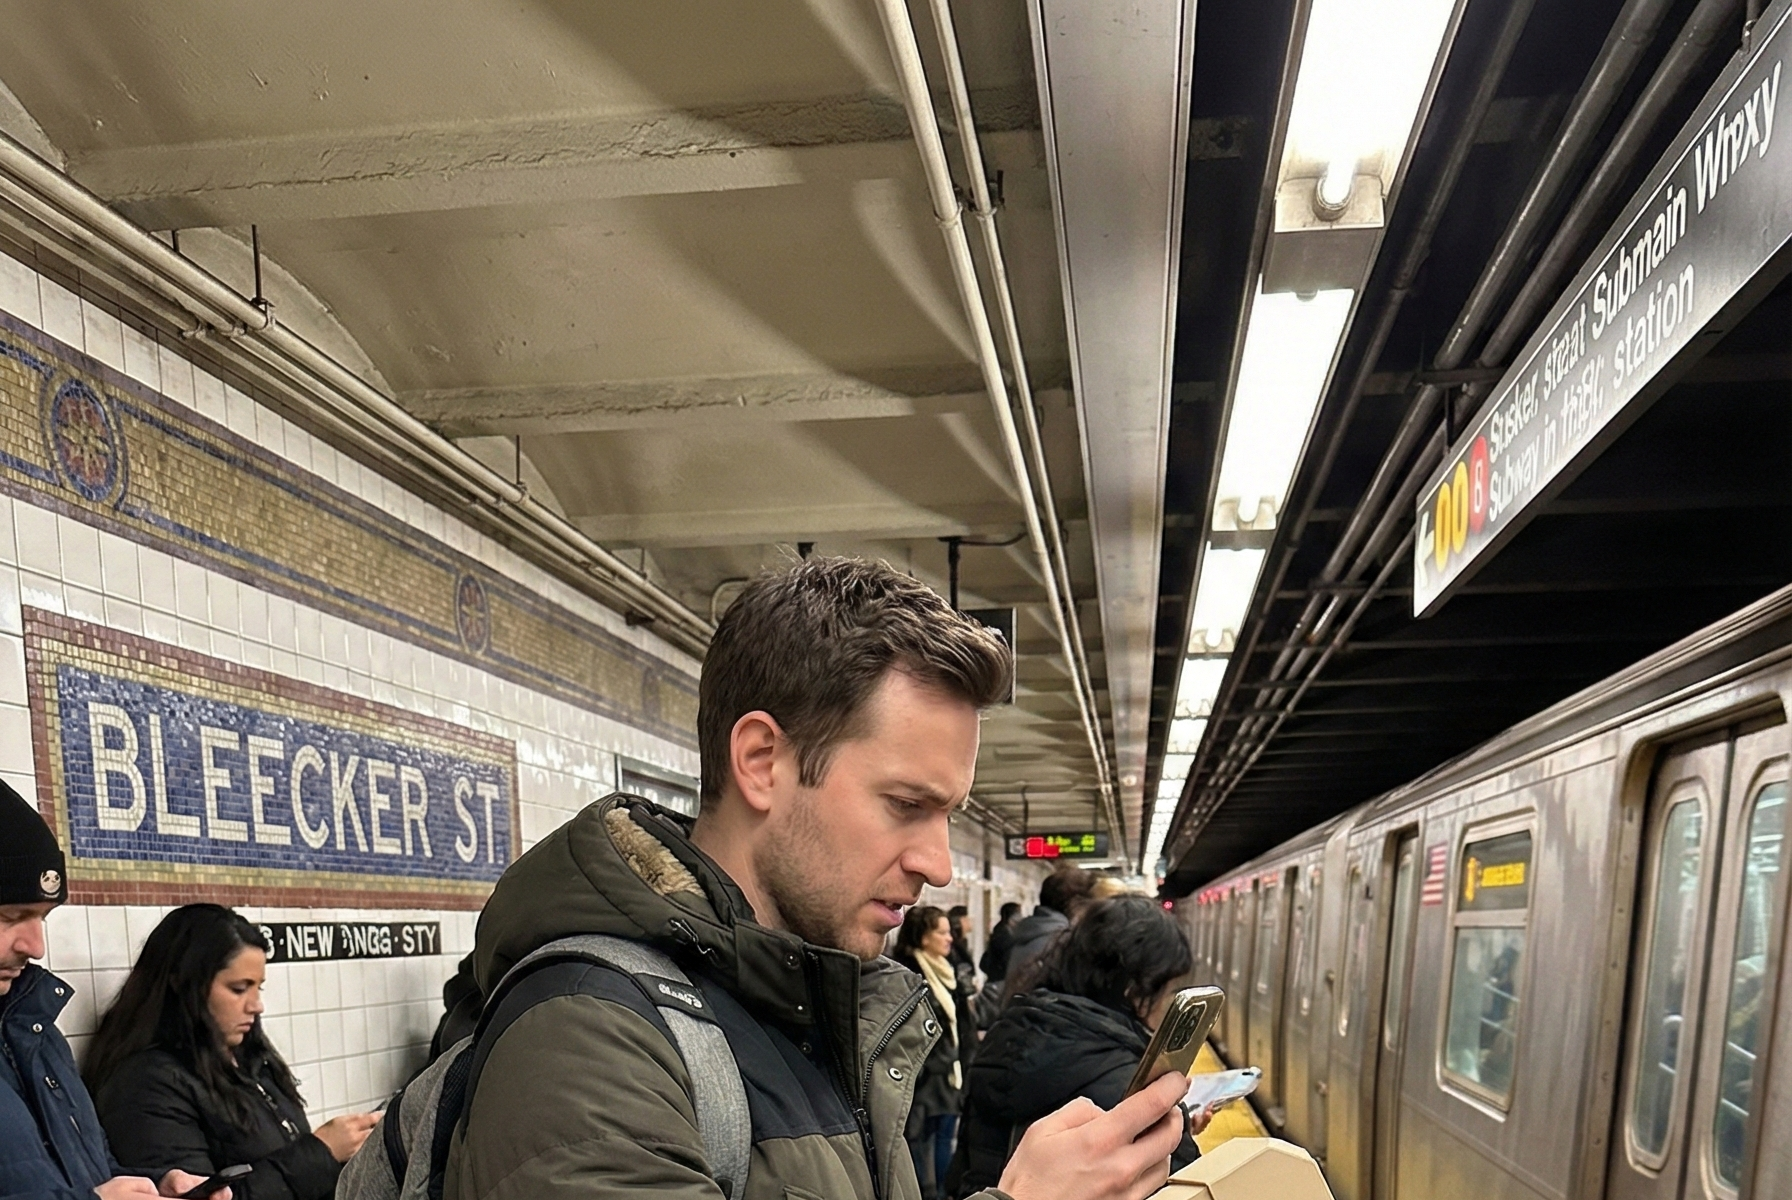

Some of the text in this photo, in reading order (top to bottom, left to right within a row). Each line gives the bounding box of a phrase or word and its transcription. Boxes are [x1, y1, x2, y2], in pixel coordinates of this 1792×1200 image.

[1592, 184, 1687, 341] Submain
[1489, 263, 1695, 522] Subway in station
[88, 701, 433, 858] BLEECKER
[286, 924, 334, 959] NEW
[402, 924, 437, 954] STY
